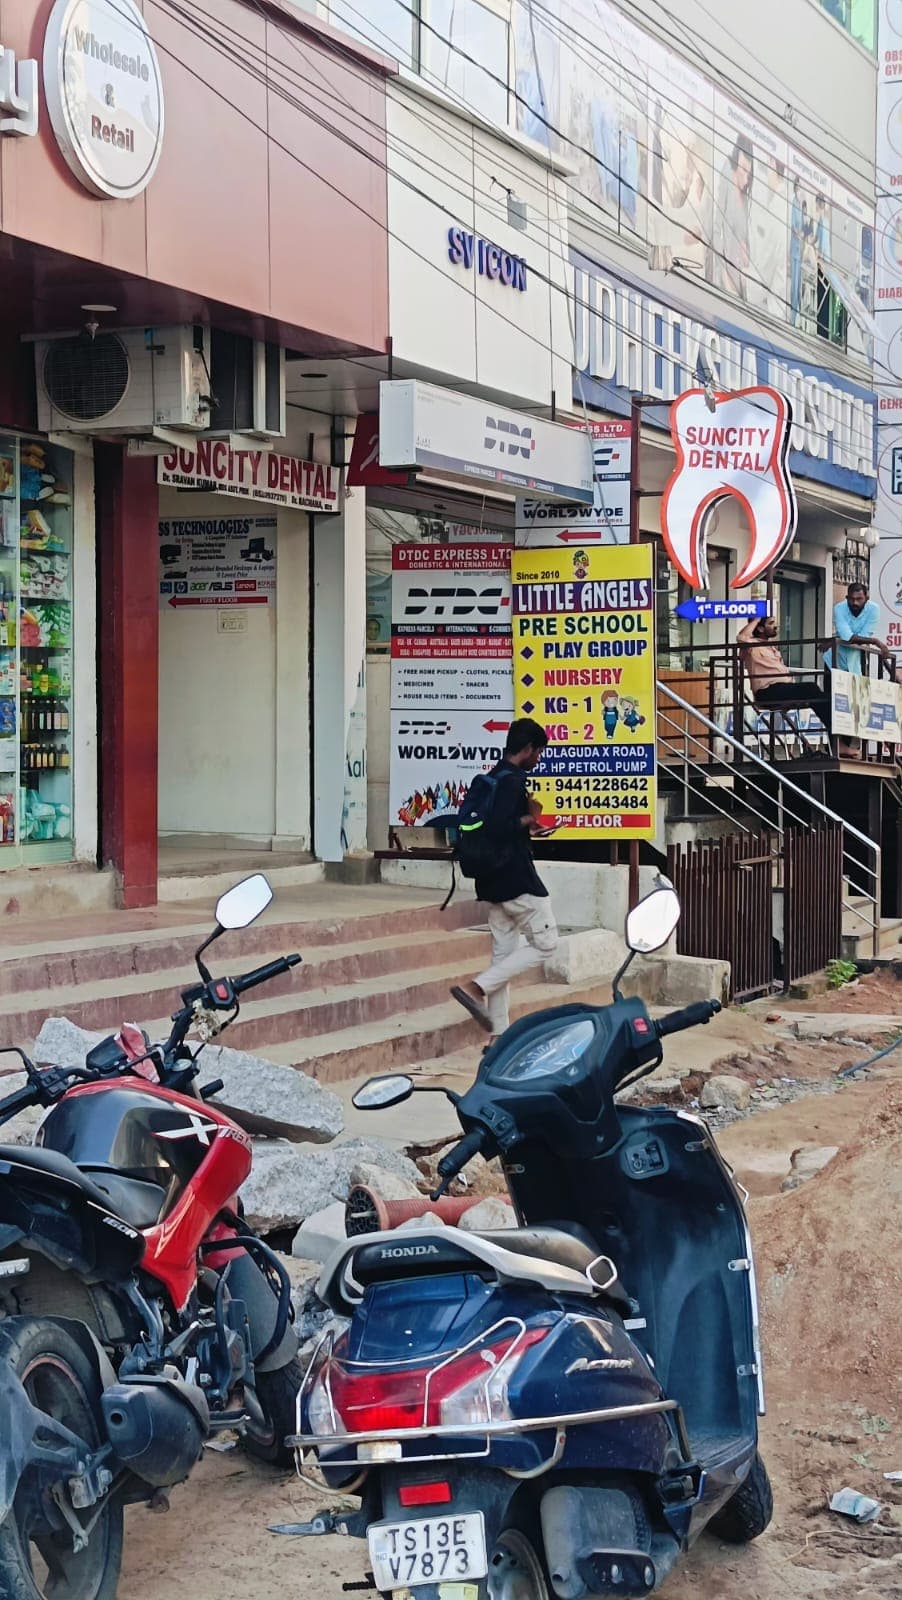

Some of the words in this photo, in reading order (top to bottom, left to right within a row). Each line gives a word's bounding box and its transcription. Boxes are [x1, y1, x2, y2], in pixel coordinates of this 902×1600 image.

[74, 25, 149, 82] Wholesale
[104, 83, 115, 107] &
[91, 114, 135, 152] Retail
[448, 227, 475, 269] SV
[478, 239, 527, 291] ICON
[603, 424, 626, 433] LTD.
[685, 426, 770, 447] SUNCITY
[688, 450, 766, 472] DENTAL
[163, 440, 262, 485] SUNCITY
[267, 453, 336, 500] DENTAL
[523, 508, 623, 518] WORLDWYDE
[172, 519, 250, 536] TECHNOLOGIES
[399, 550, 430, 560] DTDC
[434, 549, 488, 560] EXPRESS
[452, 560, 506, 568] INTERNATIONAL
[516, 572, 539, 580] Since
[540, 570, 560, 579] 2010
[190, 582, 208, 591] acer
[209, 581, 233, 591] ASUS
[404, 588, 502, 615] DTDC
[518, 584, 574, 612] LITTLE
[580, 580, 648, 611] ANGELS
[698, 604, 712, 615] 1st
[714, 604, 756, 615] FLOOR
[520, 618, 557, 636] PRE
[564, 614, 648, 635] SCHOOL
[544, 642, 583, 659] PLAY
[588, 640, 648, 658] GROUP
[544, 668, 623, 686] NURSERY
[544, 697, 568, 714] KG
[584, 697, 592, 712] 1
[545, 725, 568, 740] KG
[584, 724, 594, 740] 2
[602, 747, 610, 757] X
[612, 746, 648, 758] ROAD,
[551, 762, 566, 773] HP
[568, 762, 613, 773] PETROL
[615, 761, 647, 772] PUMP
[526, 780, 541, 791] Ph
[555, 778, 648, 791] 9441228642
[555, 796, 648, 809] 9110443484
[576, 815, 622, 827] FLOOR
[381, 1244, 439, 1259] HONDA
[388, 1520, 466, 1554] TS13E
[389, 1548, 470, 1580] V7873
